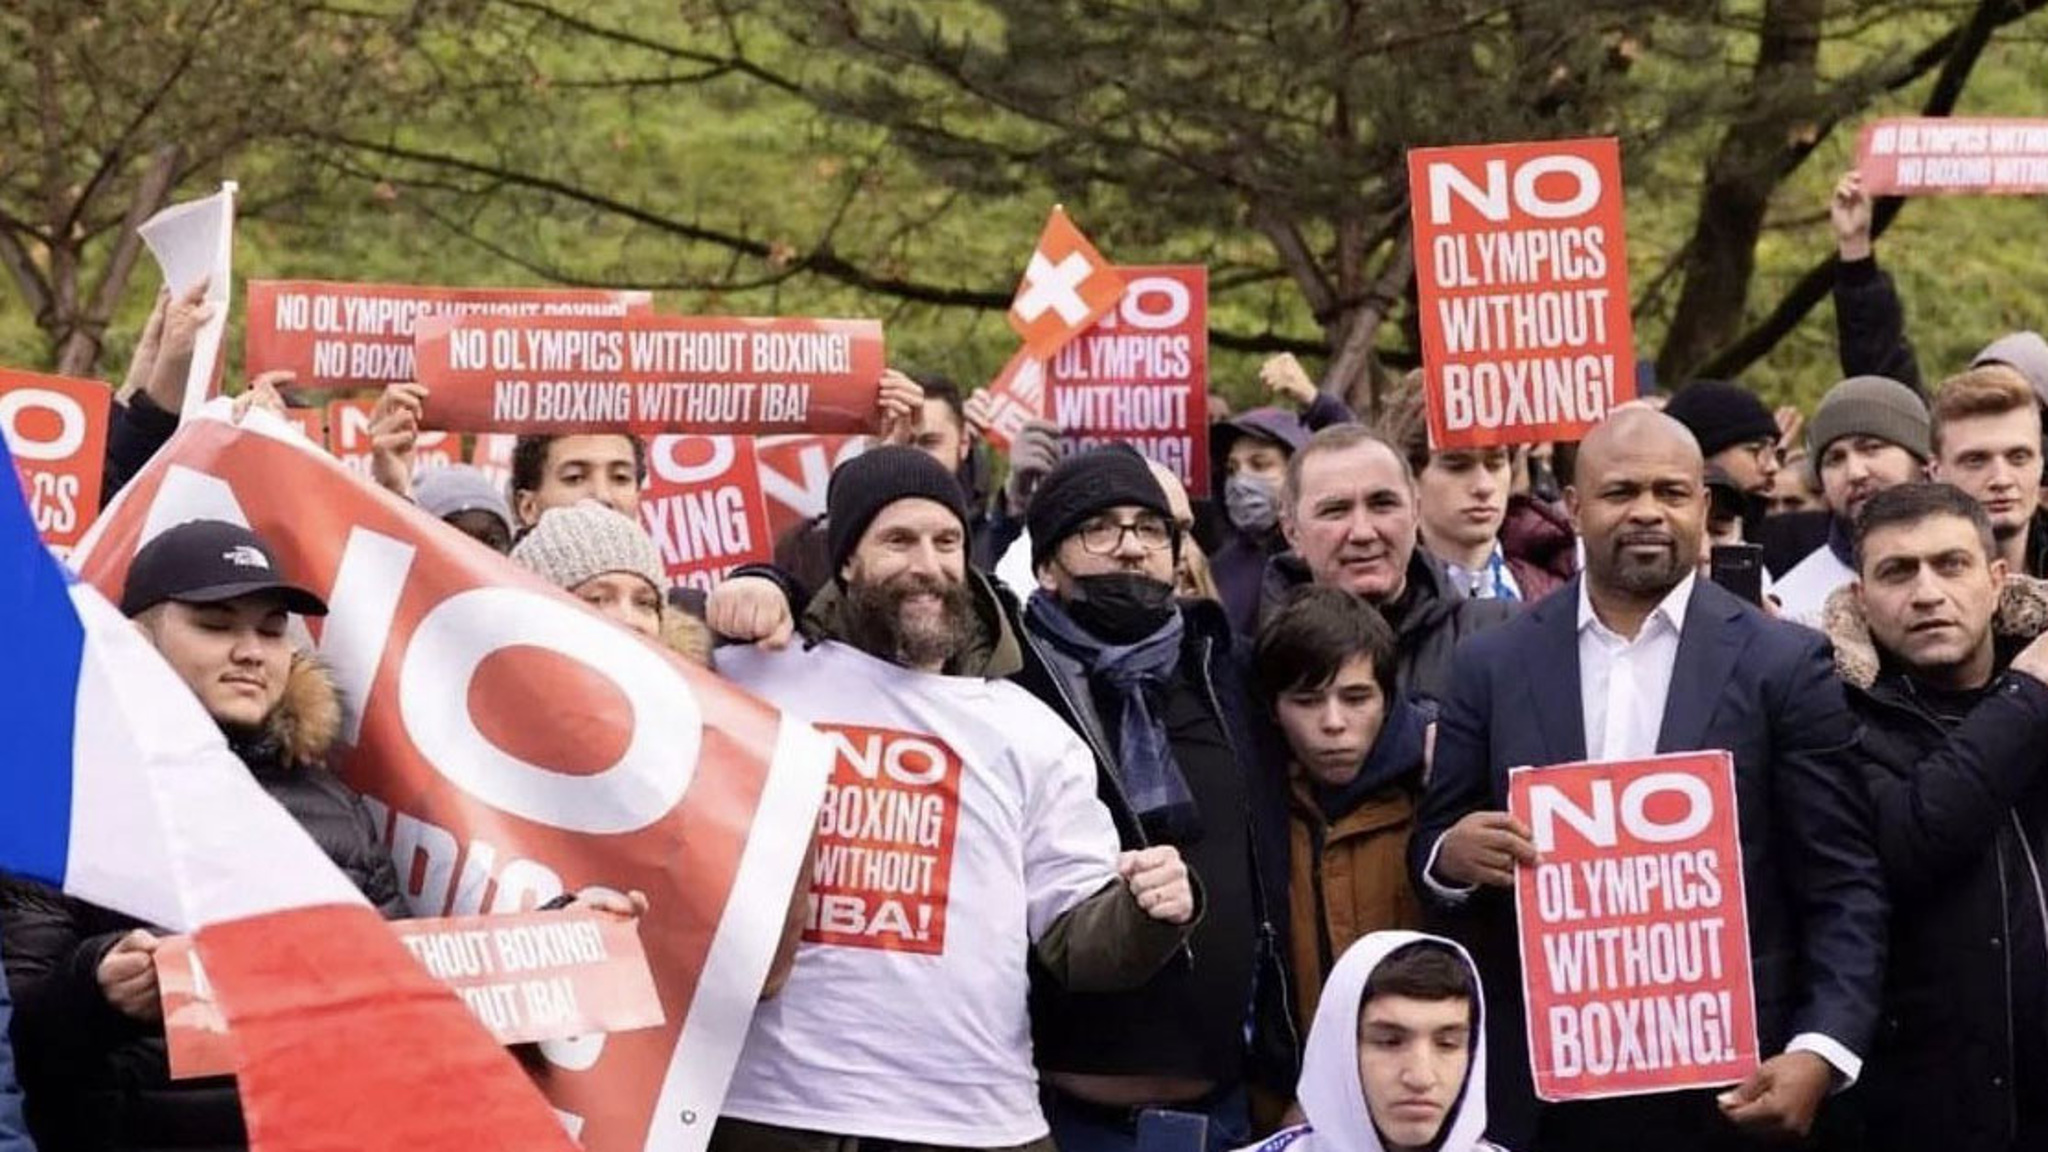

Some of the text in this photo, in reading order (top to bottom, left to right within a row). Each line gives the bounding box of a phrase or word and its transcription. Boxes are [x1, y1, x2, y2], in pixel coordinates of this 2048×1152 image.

[1428, 155, 1601, 225] NO
[1434, 226, 1607, 288] OLYMPICS
[275, 294, 309, 331] NO
[1099, 277, 1190, 329] O
[1439, 289, 1609, 354] WITHOUT
[314, 340, 345, 377] NO
[450, 328, 850, 374] NO OLYMPICS WITHOUT BOXING!
[1055, 334, 1192, 380] OLYMPICS
[494, 381, 809, 423] NO BOXING WITHOUT IBA!
[1054, 384, 1192, 431] WITHOUT
[1442, 354, 1615, 430] BOXING!
[0, 388, 86, 461] O
[641, 434, 735, 488] O
[640, 486, 752, 564] XING
[827, 730, 947, 786] NO
[818, 784, 944, 849] BOXING
[1529, 772, 1714, 852] NO
[813, 845, 937, 896] WITHOUT
[1537, 849, 1722, 923] OLYMPICS
[806, 893, 932, 942] IBA!
[400, 919, 607, 980] THOUT BOXING!
[1542, 918, 1725, 995] WITHOUT
[1550, 991, 1736, 1078] BOXING!
